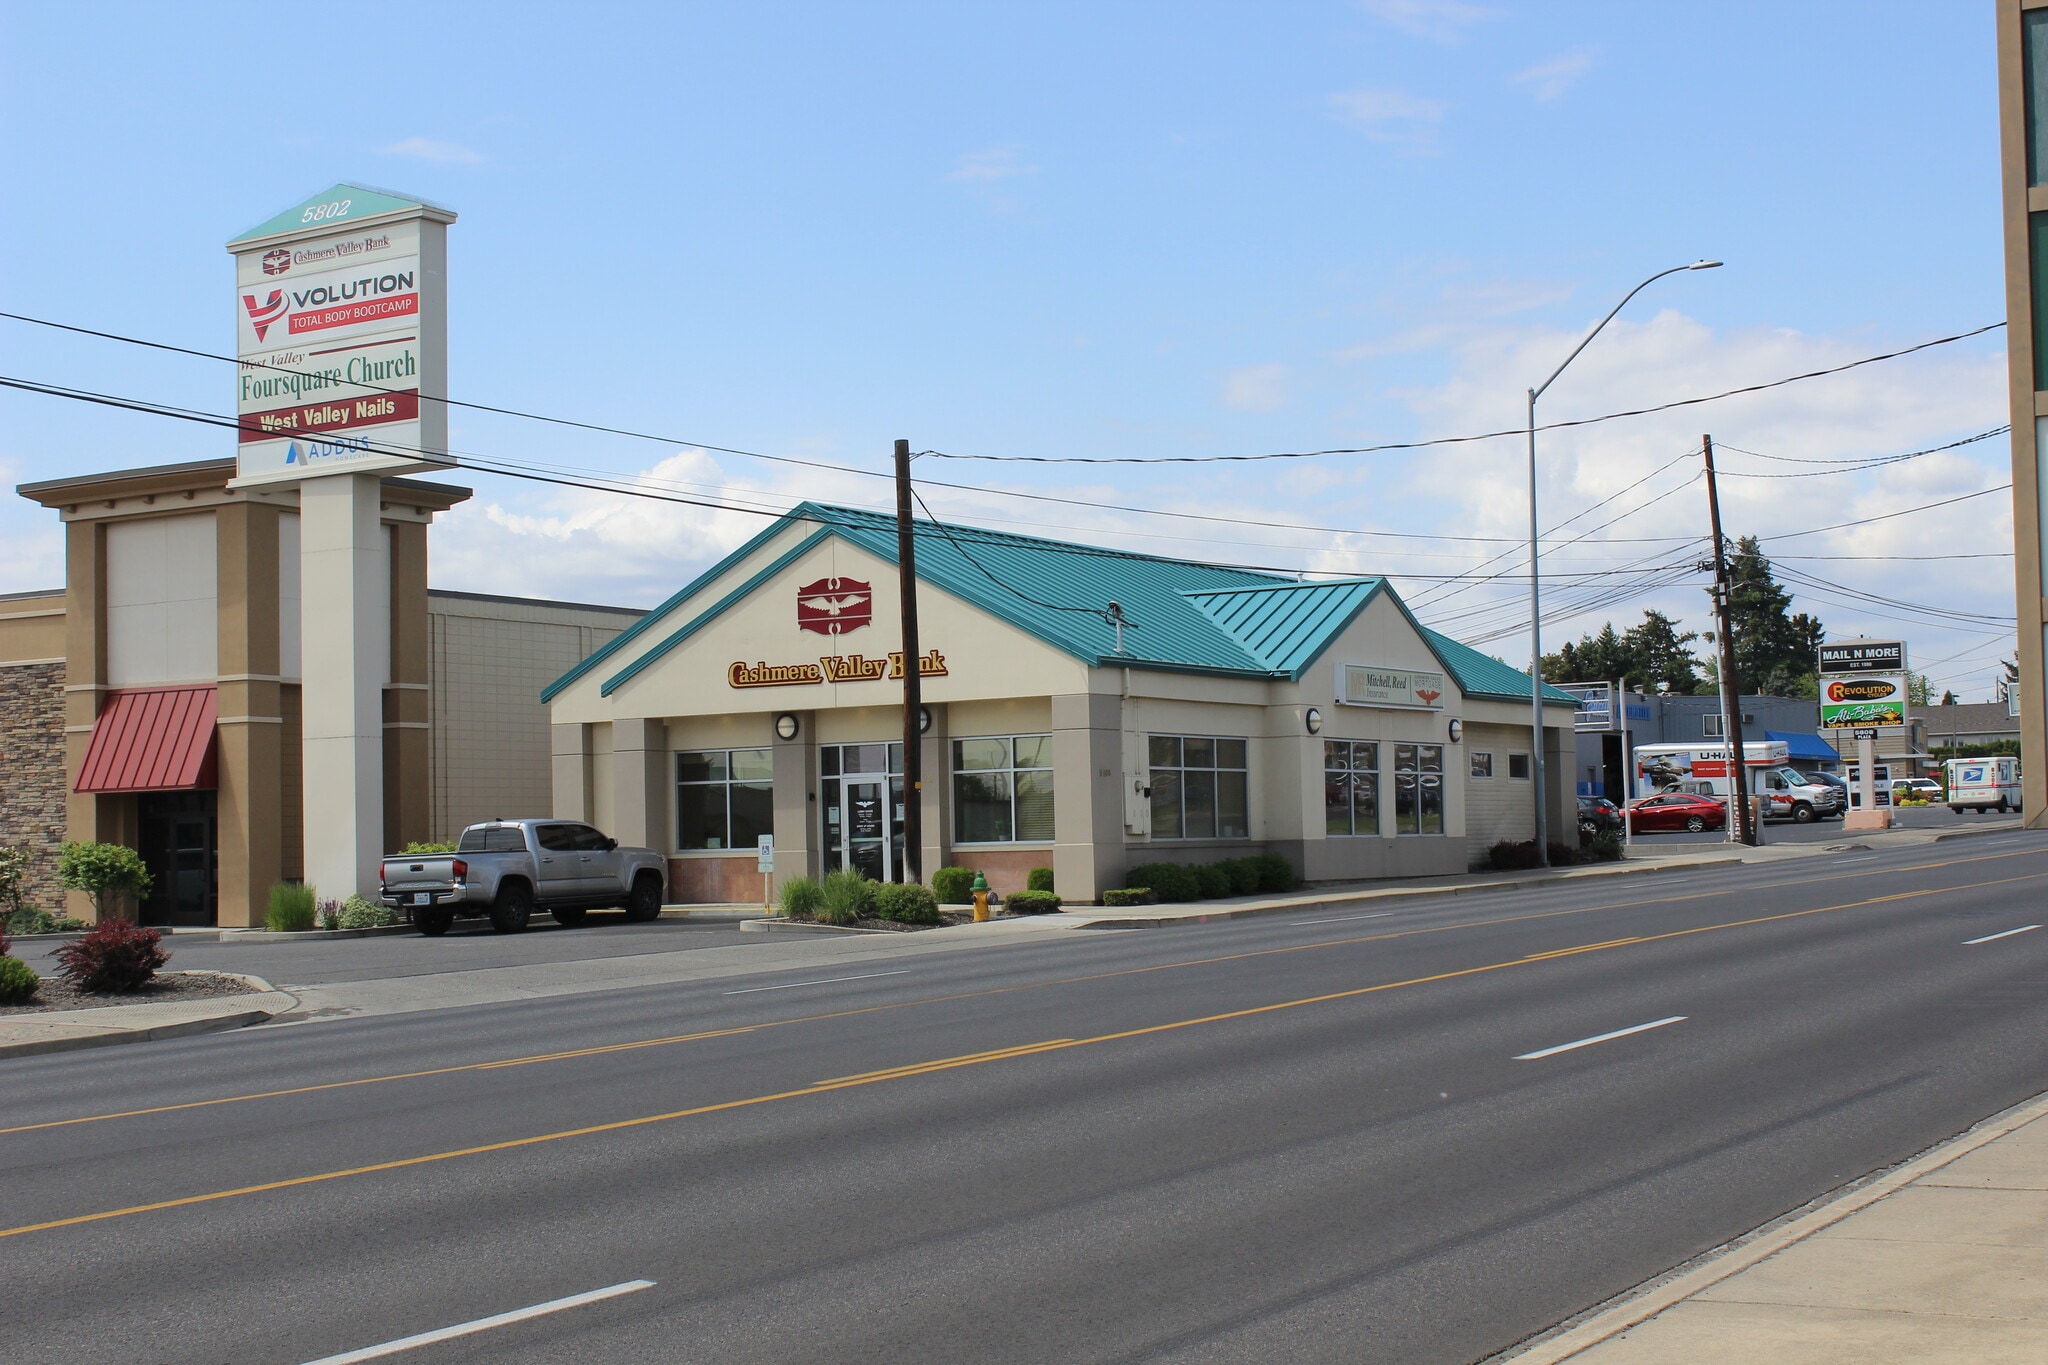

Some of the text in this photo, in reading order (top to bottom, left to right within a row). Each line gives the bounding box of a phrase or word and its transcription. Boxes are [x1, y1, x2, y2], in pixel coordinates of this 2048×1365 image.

[301, 199, 352, 223] 5802
[294, 235, 390, 265] Cashmere Valley Bank
[293, 271, 414, 308] VOLUTION
[293, 298, 412, 329] TOTAL BODY BOOTCAMP
[240, 352, 305, 371] West Valley
[241, 349, 416, 401] Foursquare Church
[260, 398, 396, 432] West Valley Nails
[309, 435, 369, 459] ADDUS
[1823, 647, 1899, 660] MAIL N MORE
[728, 649, 948, 688] Cashmere Valley Bnk
[1366, 673, 1392, 689] Mitchell,
[1392, 677, 1407, 689] Reed
[1833, 685, 1893, 698] REVOLUTION
[1881, 719, 1901, 727] SHOP
